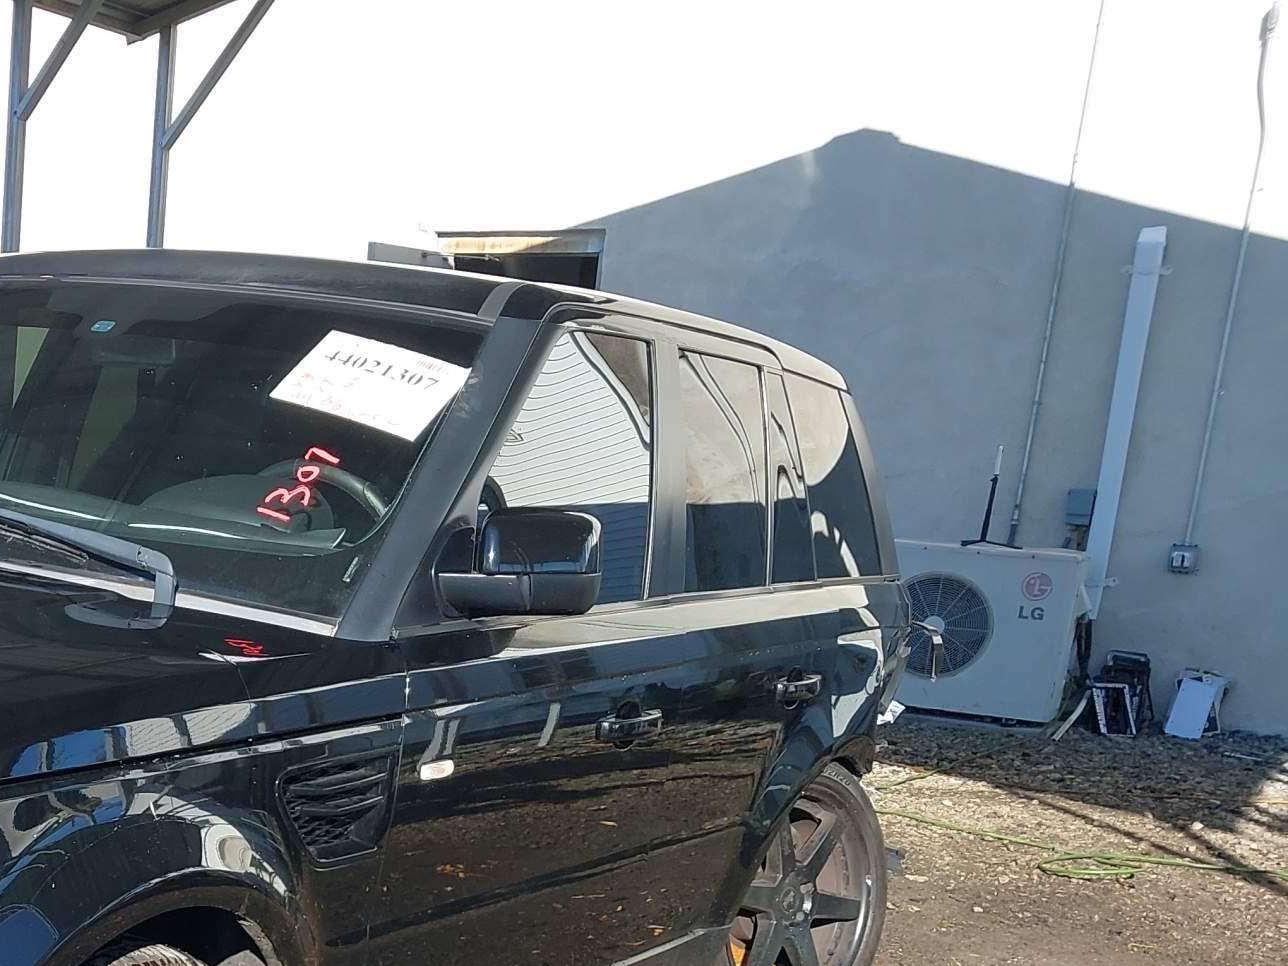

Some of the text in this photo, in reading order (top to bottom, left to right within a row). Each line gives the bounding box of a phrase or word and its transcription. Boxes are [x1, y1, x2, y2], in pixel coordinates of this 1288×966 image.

[324, 350, 440, 391] 44021307
[256, 446, 341, 521] 1307
[1018, 605, 1045, 621] LG
